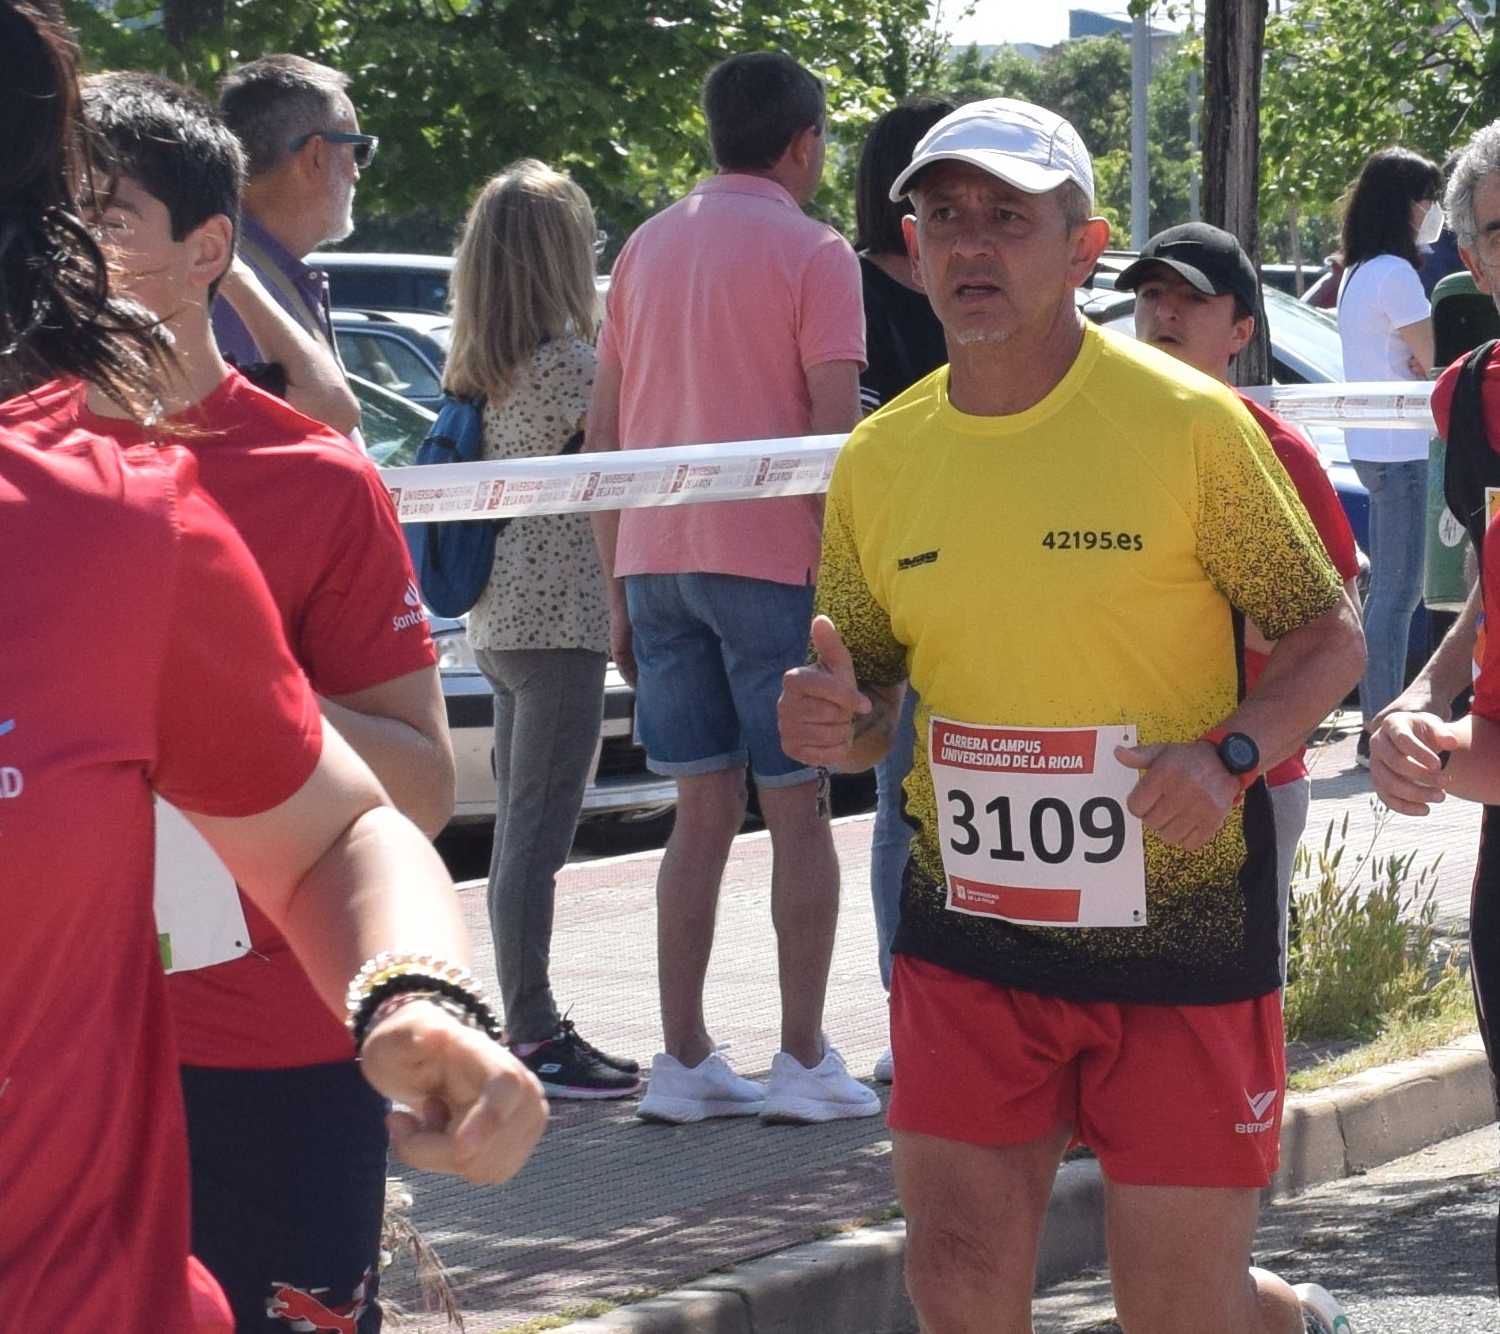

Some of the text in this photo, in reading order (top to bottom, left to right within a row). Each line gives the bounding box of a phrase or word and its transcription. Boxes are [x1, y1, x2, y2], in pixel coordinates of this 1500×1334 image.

[1041, 531, 1143, 551] 42195.es
[943, 732, 1041, 754] CARRERA CAMPUS
[941, 746, 1083, 769] UNIVERSIDAD DE LA RIOJA
[947, 788, 1125, 864] 3109
